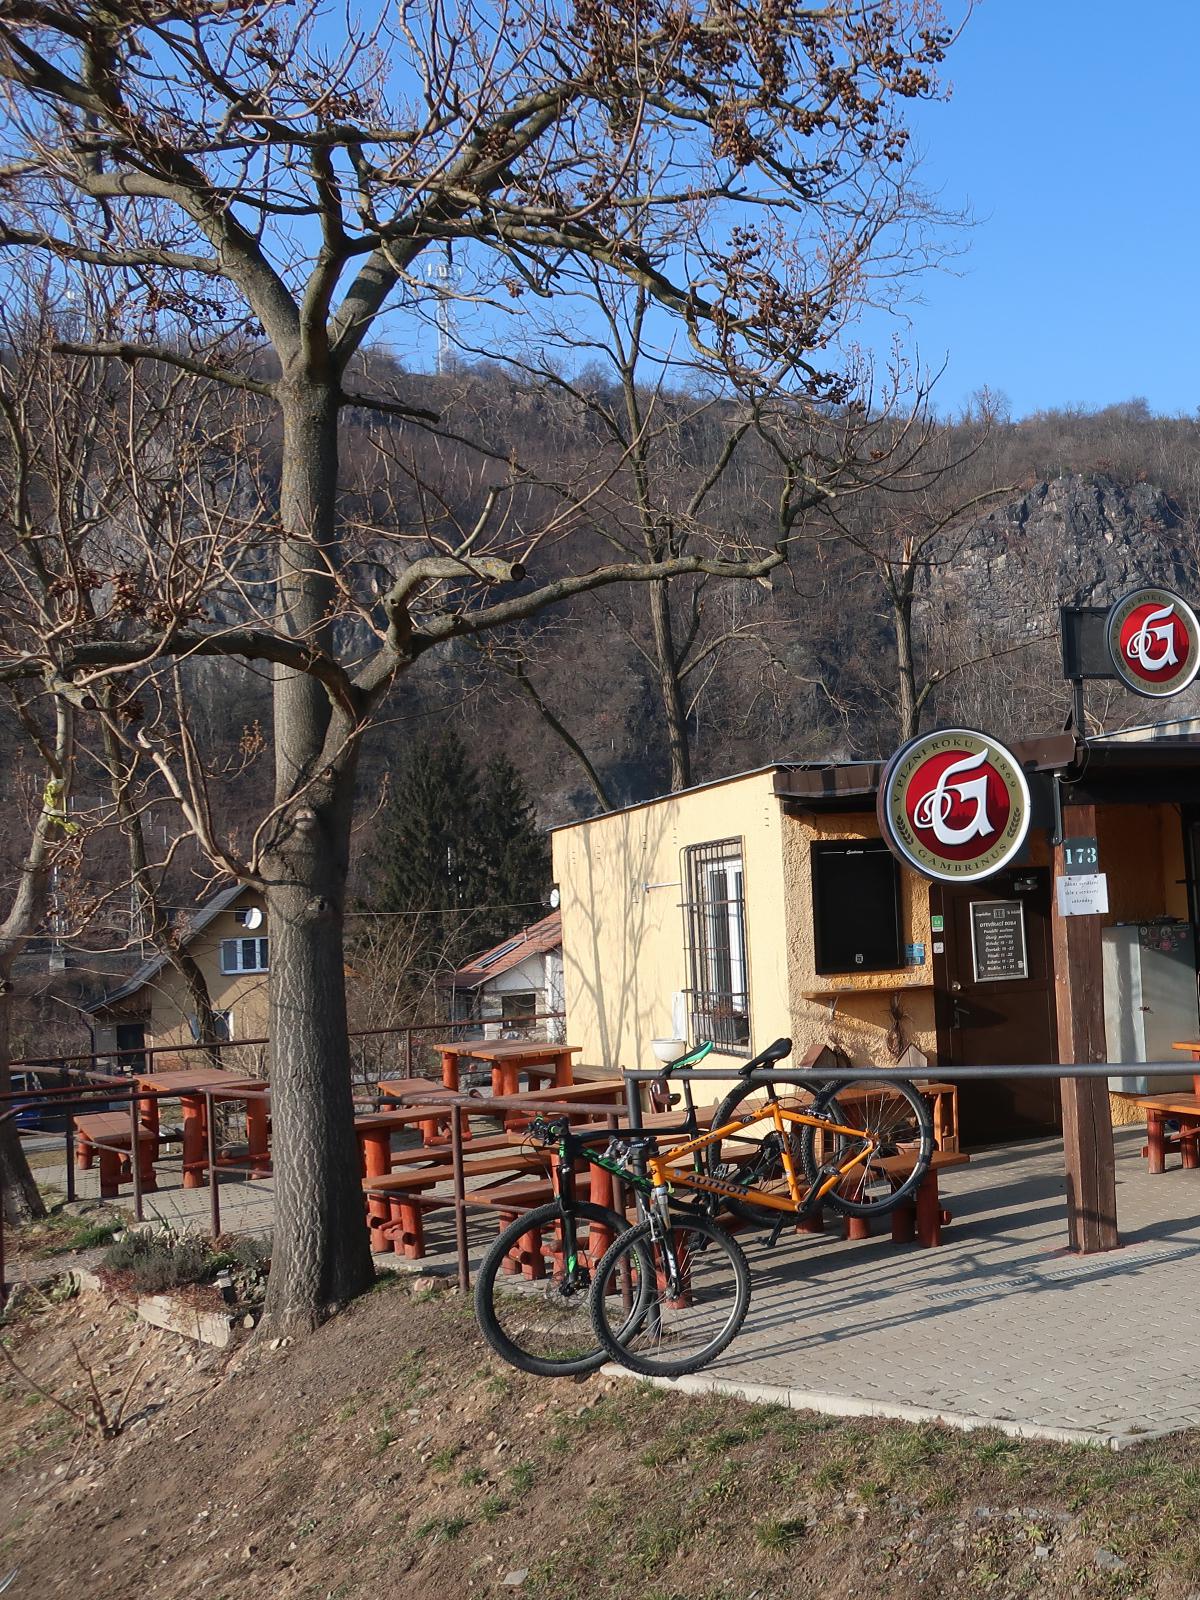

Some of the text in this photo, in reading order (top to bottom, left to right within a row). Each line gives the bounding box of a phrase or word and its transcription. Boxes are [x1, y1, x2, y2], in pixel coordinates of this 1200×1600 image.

[896, 749, 928, 788] PLZNI
[931, 739, 974, 750] ROKU
[994, 755, 1017, 789] 1869
[917, 843, 1008, 872] GAMBRINUS
[1065, 847, 1097, 865] 173
[684, 1174, 749, 1196] AUTHOR
